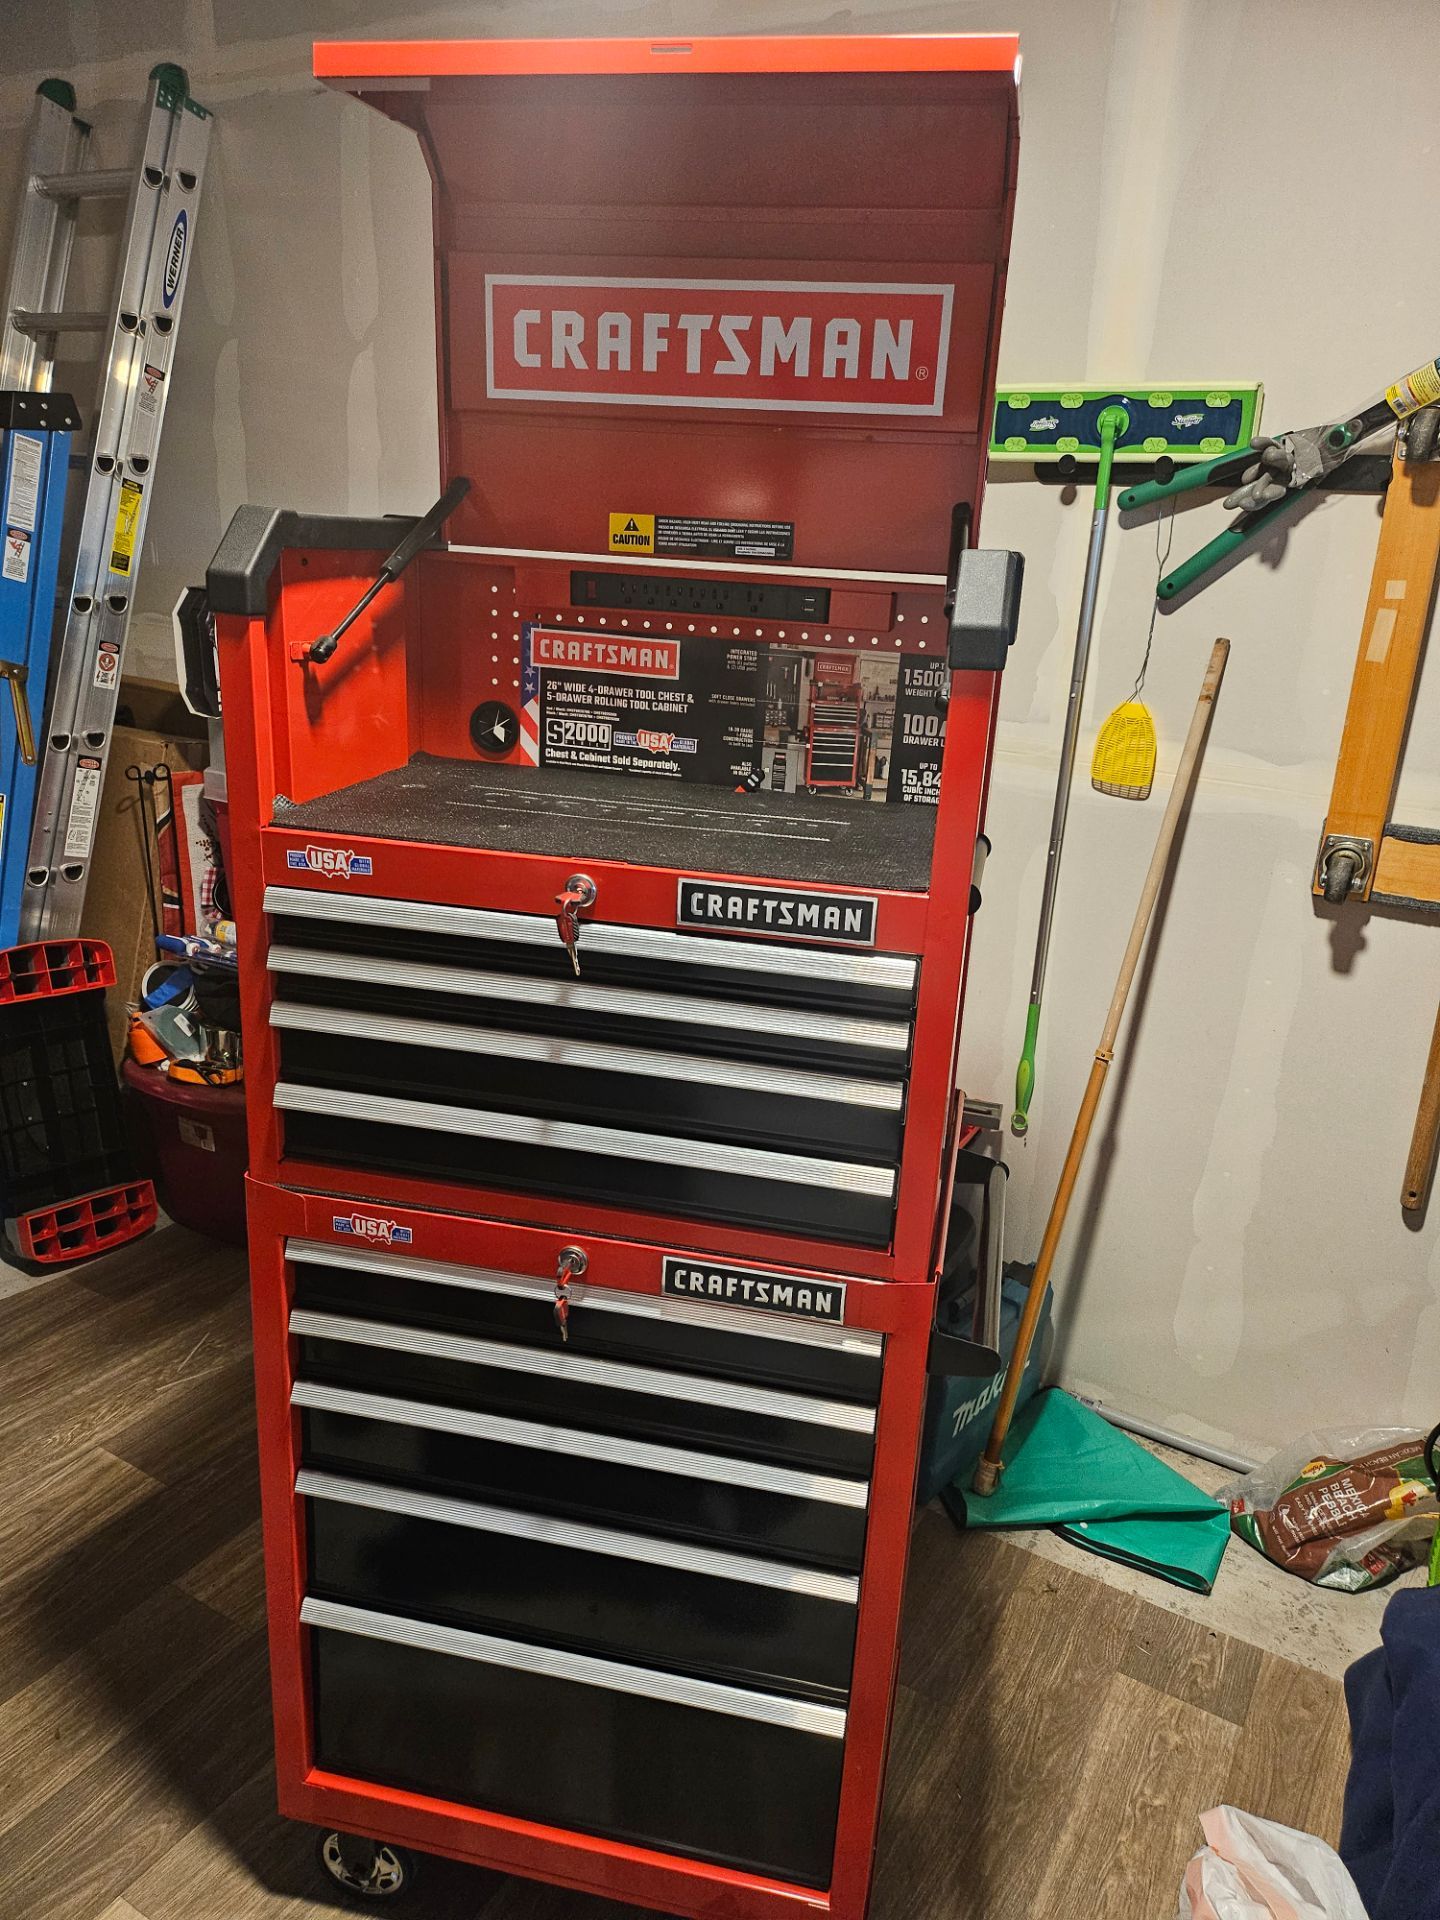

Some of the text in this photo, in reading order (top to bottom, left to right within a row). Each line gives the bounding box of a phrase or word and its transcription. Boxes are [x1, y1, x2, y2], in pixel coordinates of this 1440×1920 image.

[166, 227, 184, 290] WERNER
[513, 309, 914, 381] CRAFTSMAN
[612, 533, 651, 547] CAUTION
[539, 638, 669, 670] CRAFTSMAN
[930, 662, 940, 670] UP
[904, 669, 945, 687] 1,500
[546, 680, 562, 691] 26"
[563, 682, 587, 693] WIDE
[587, 684, 634, 699] 4-DRAWER
[635, 688, 656, 701] TOOL
[657, 690, 686, 703] CHEST
[687, 693, 695, 704] &
[905, 688, 933, 698] WEIGHT
[546, 691, 689, 714] 5-DRAWER ROLLING TOOL CABINET
[640, 733, 669, 749] USA
[902, 735, 939, 747] DRAWER
[545, 748, 569, 760] Chest
[570, 751, 578, 761] &
[578, 751, 612, 764] Cabinet
[612, 755, 632, 766] Sold
[632, 757, 682, 772] Separately.
[919, 762, 938, 771] UP TO
[901, 769, 942, 789] 15,84
[902, 785, 941, 796] CUBIC INCH
[903, 793, 940, 805] OF STORAG
[310, 850, 348, 871] USA
[690, 892, 863, 933] CRAFTSMAN
[355, 1218, 390, 1238] USA
[674, 1269, 833, 1314] CRAFTSMAN
[1330, 1482, 1358, 1521] BEACH
[1341, 1477, 1370, 1518] MEXICA
